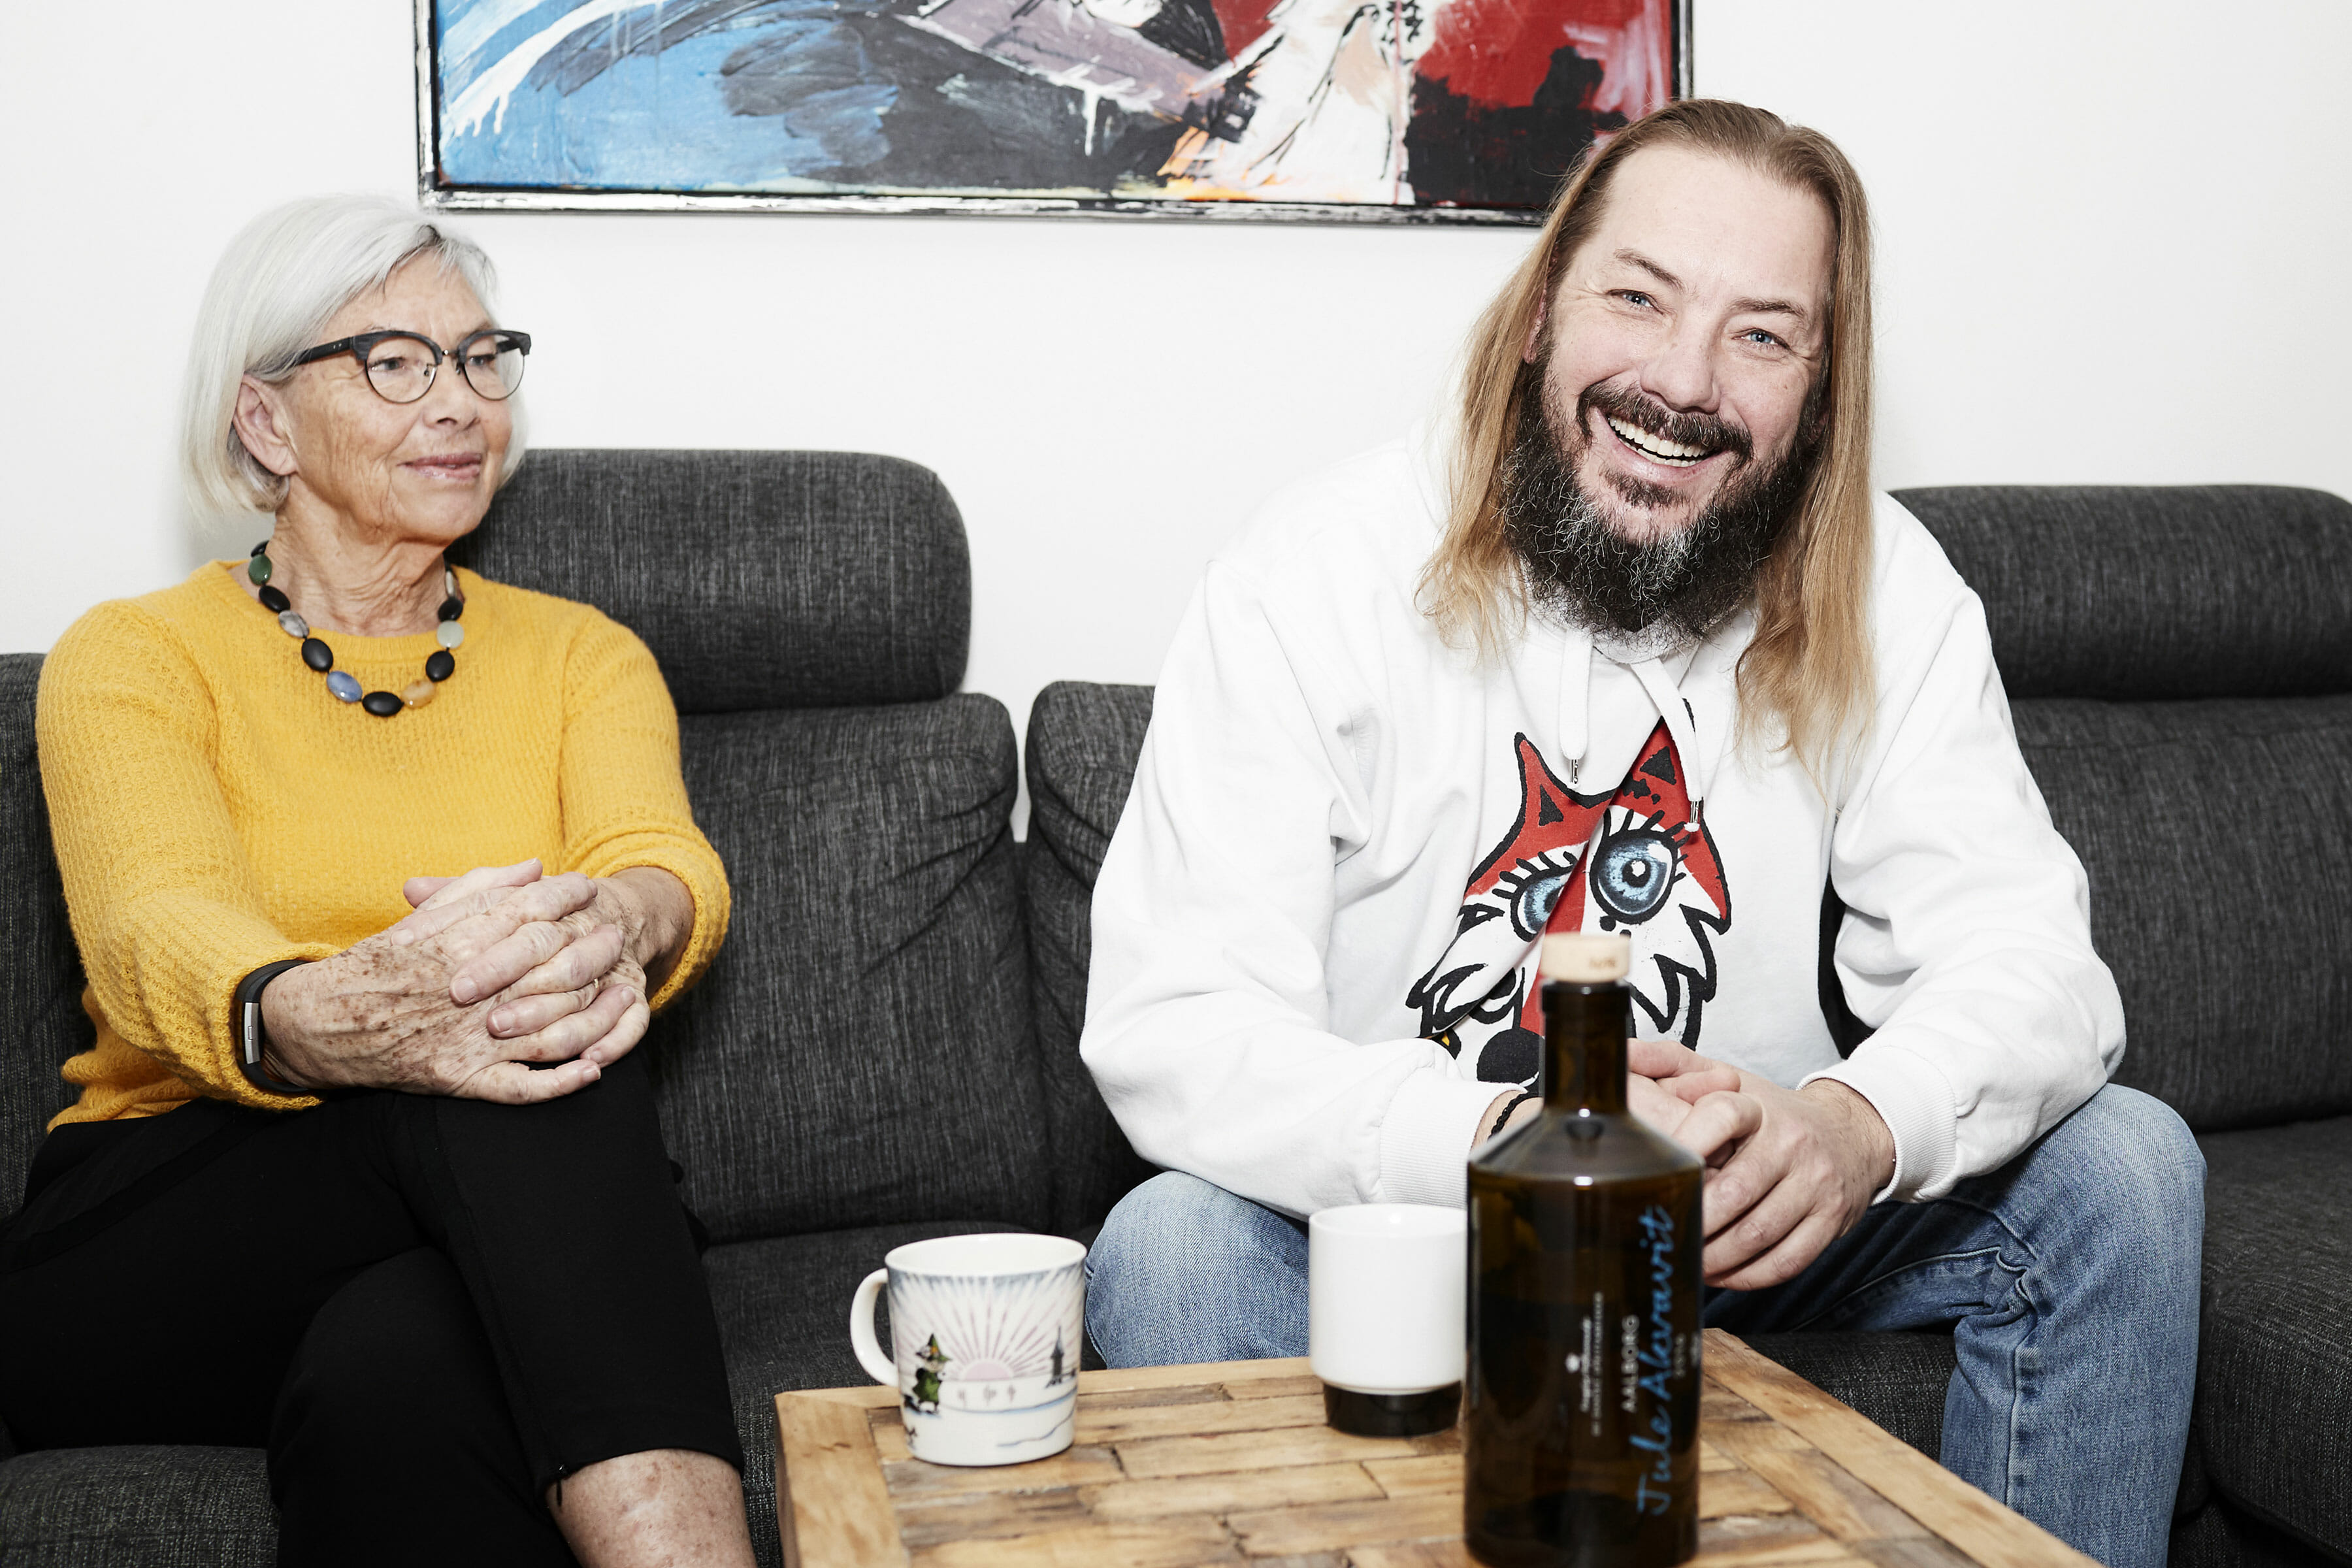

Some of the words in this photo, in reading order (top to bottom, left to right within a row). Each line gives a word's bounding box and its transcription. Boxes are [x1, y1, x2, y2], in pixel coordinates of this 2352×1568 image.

[1638, 1205, 1675, 1400] Akvavit
[1623, 1313, 1640, 1411] AALBORG
[1631, 1406, 1671, 1516] Jule
